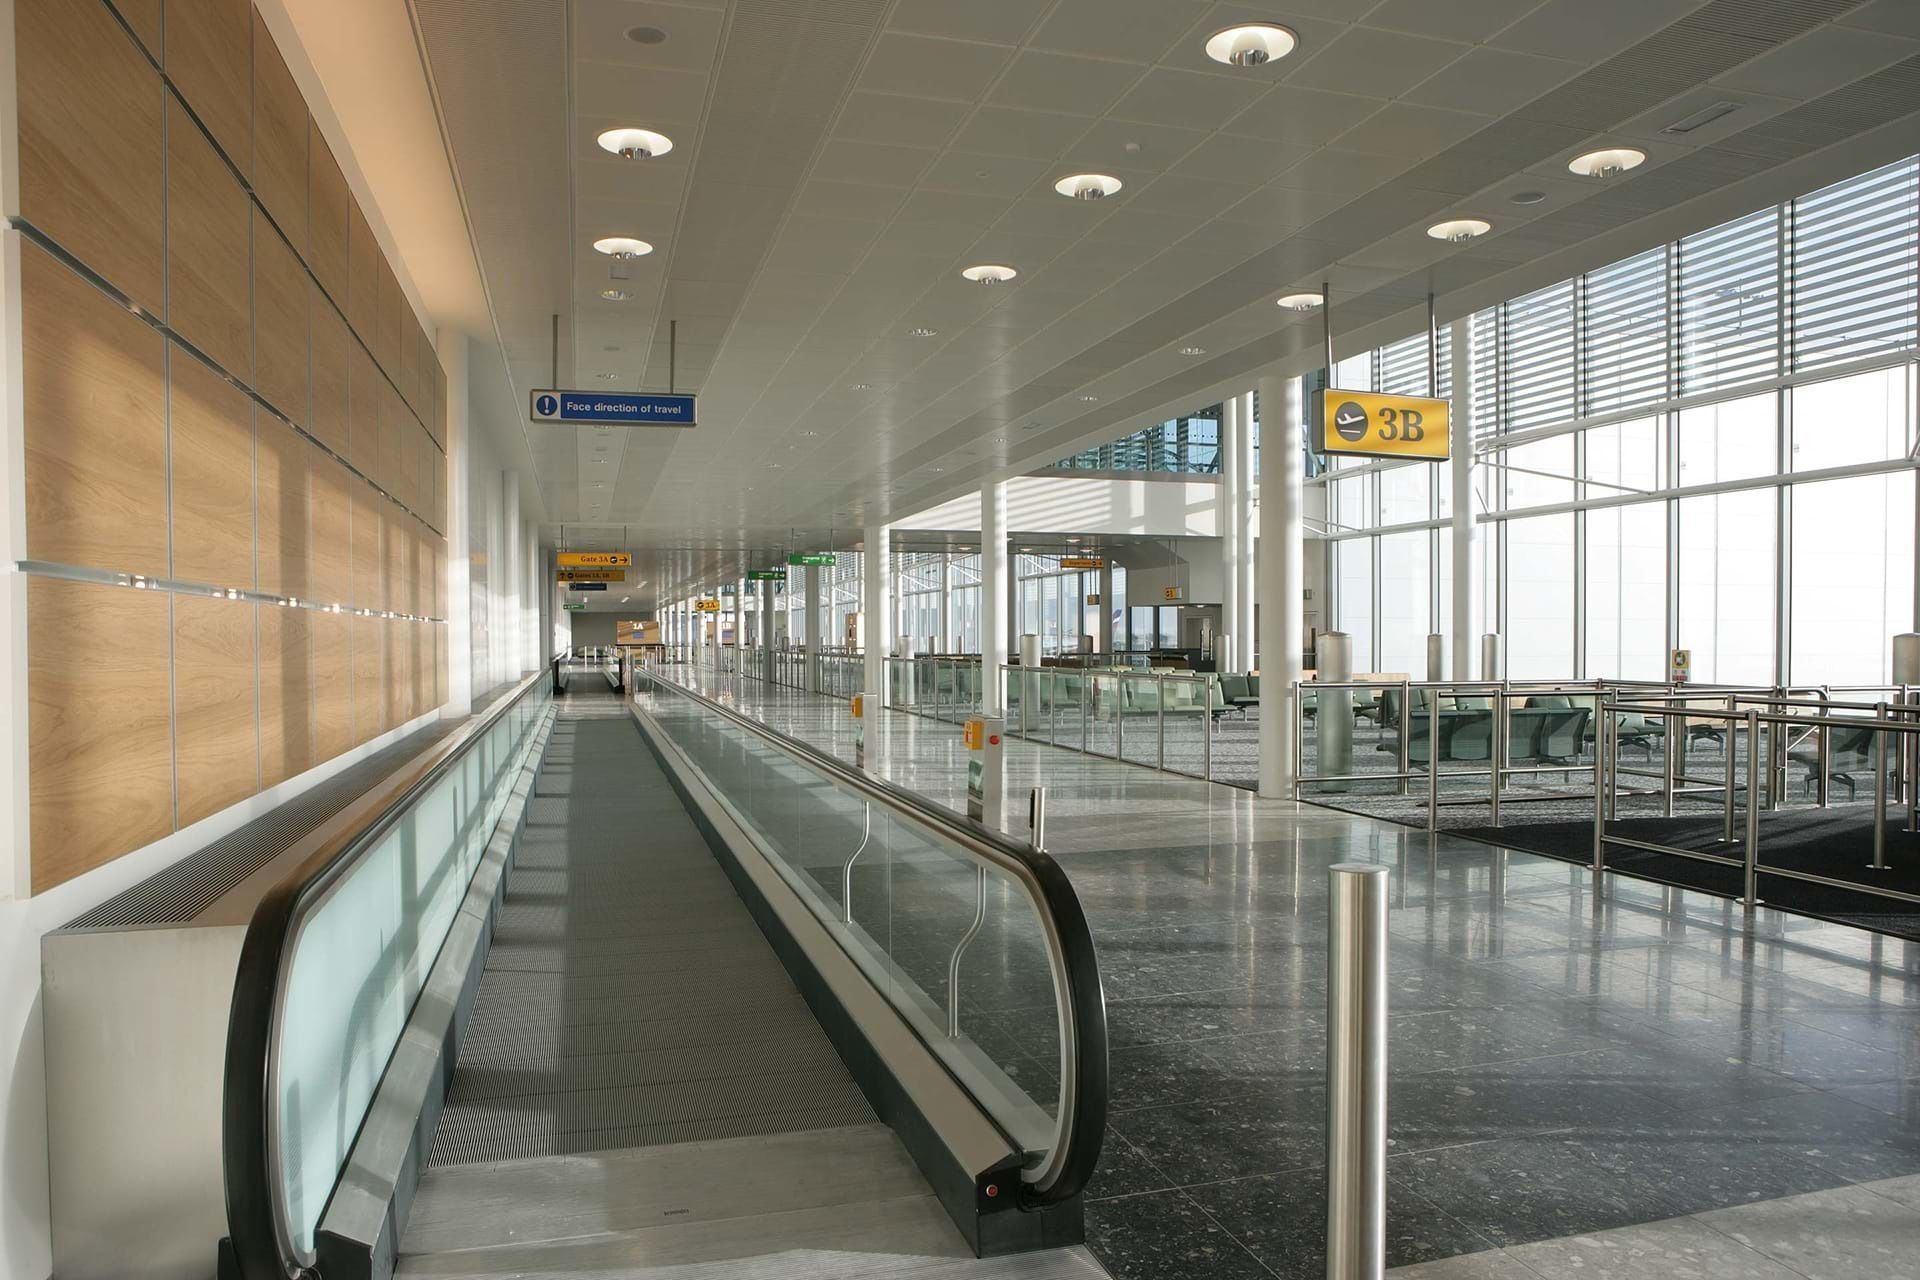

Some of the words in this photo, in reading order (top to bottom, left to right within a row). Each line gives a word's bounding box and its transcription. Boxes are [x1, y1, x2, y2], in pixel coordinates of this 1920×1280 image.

[567, 401, 591, 412] Face
[594, 402, 638, 413] direction
[640, 403, 651, 413] of
[654, 405, 681, 414] travel
[1378, 407, 1424, 442] 3B
